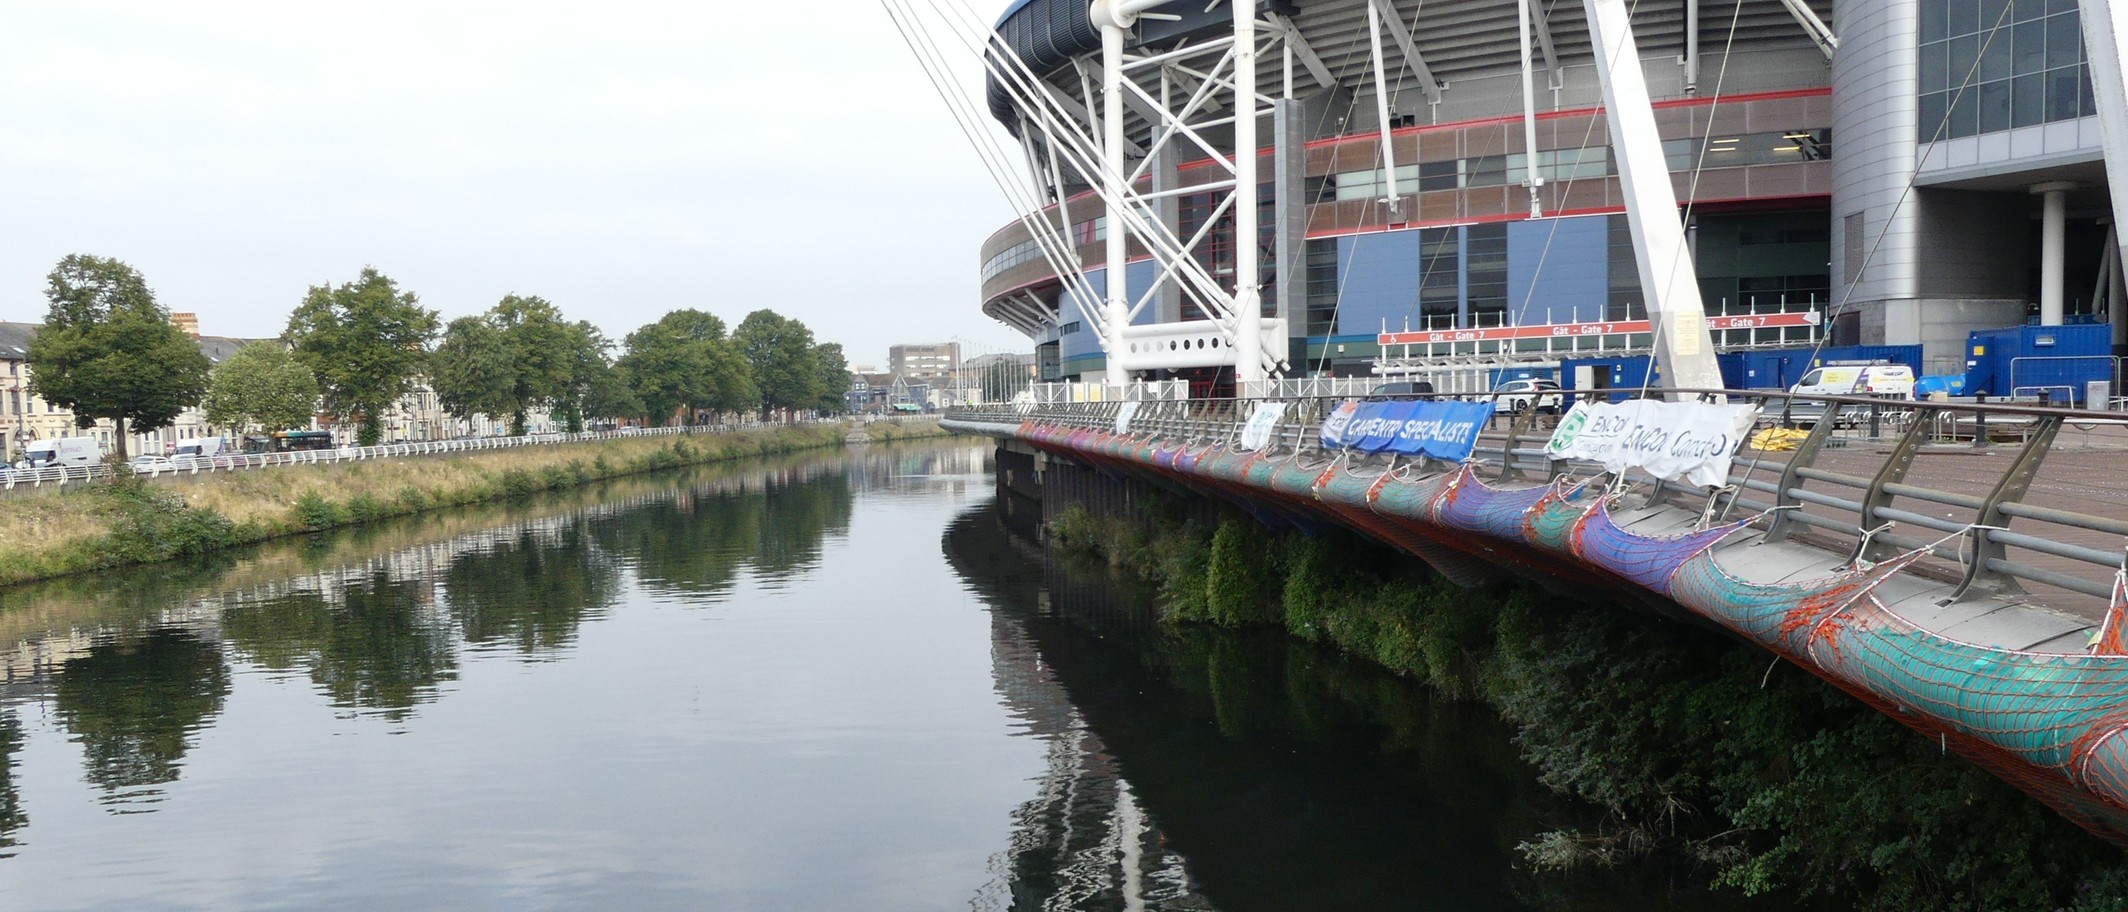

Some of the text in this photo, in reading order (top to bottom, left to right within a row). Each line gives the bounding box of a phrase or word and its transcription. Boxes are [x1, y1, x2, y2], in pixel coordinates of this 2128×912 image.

[1706, 319, 1716, 328] ât
[1730, 318, 1754, 327] Gate
[1759, 316, 1766, 326] 7
[1581, 325, 1602, 334] Gate
[1607, 324, 1614, 333] 7
[1455, 332, 1475, 340] Gate
[1479, 331, 1485, 339] 7
